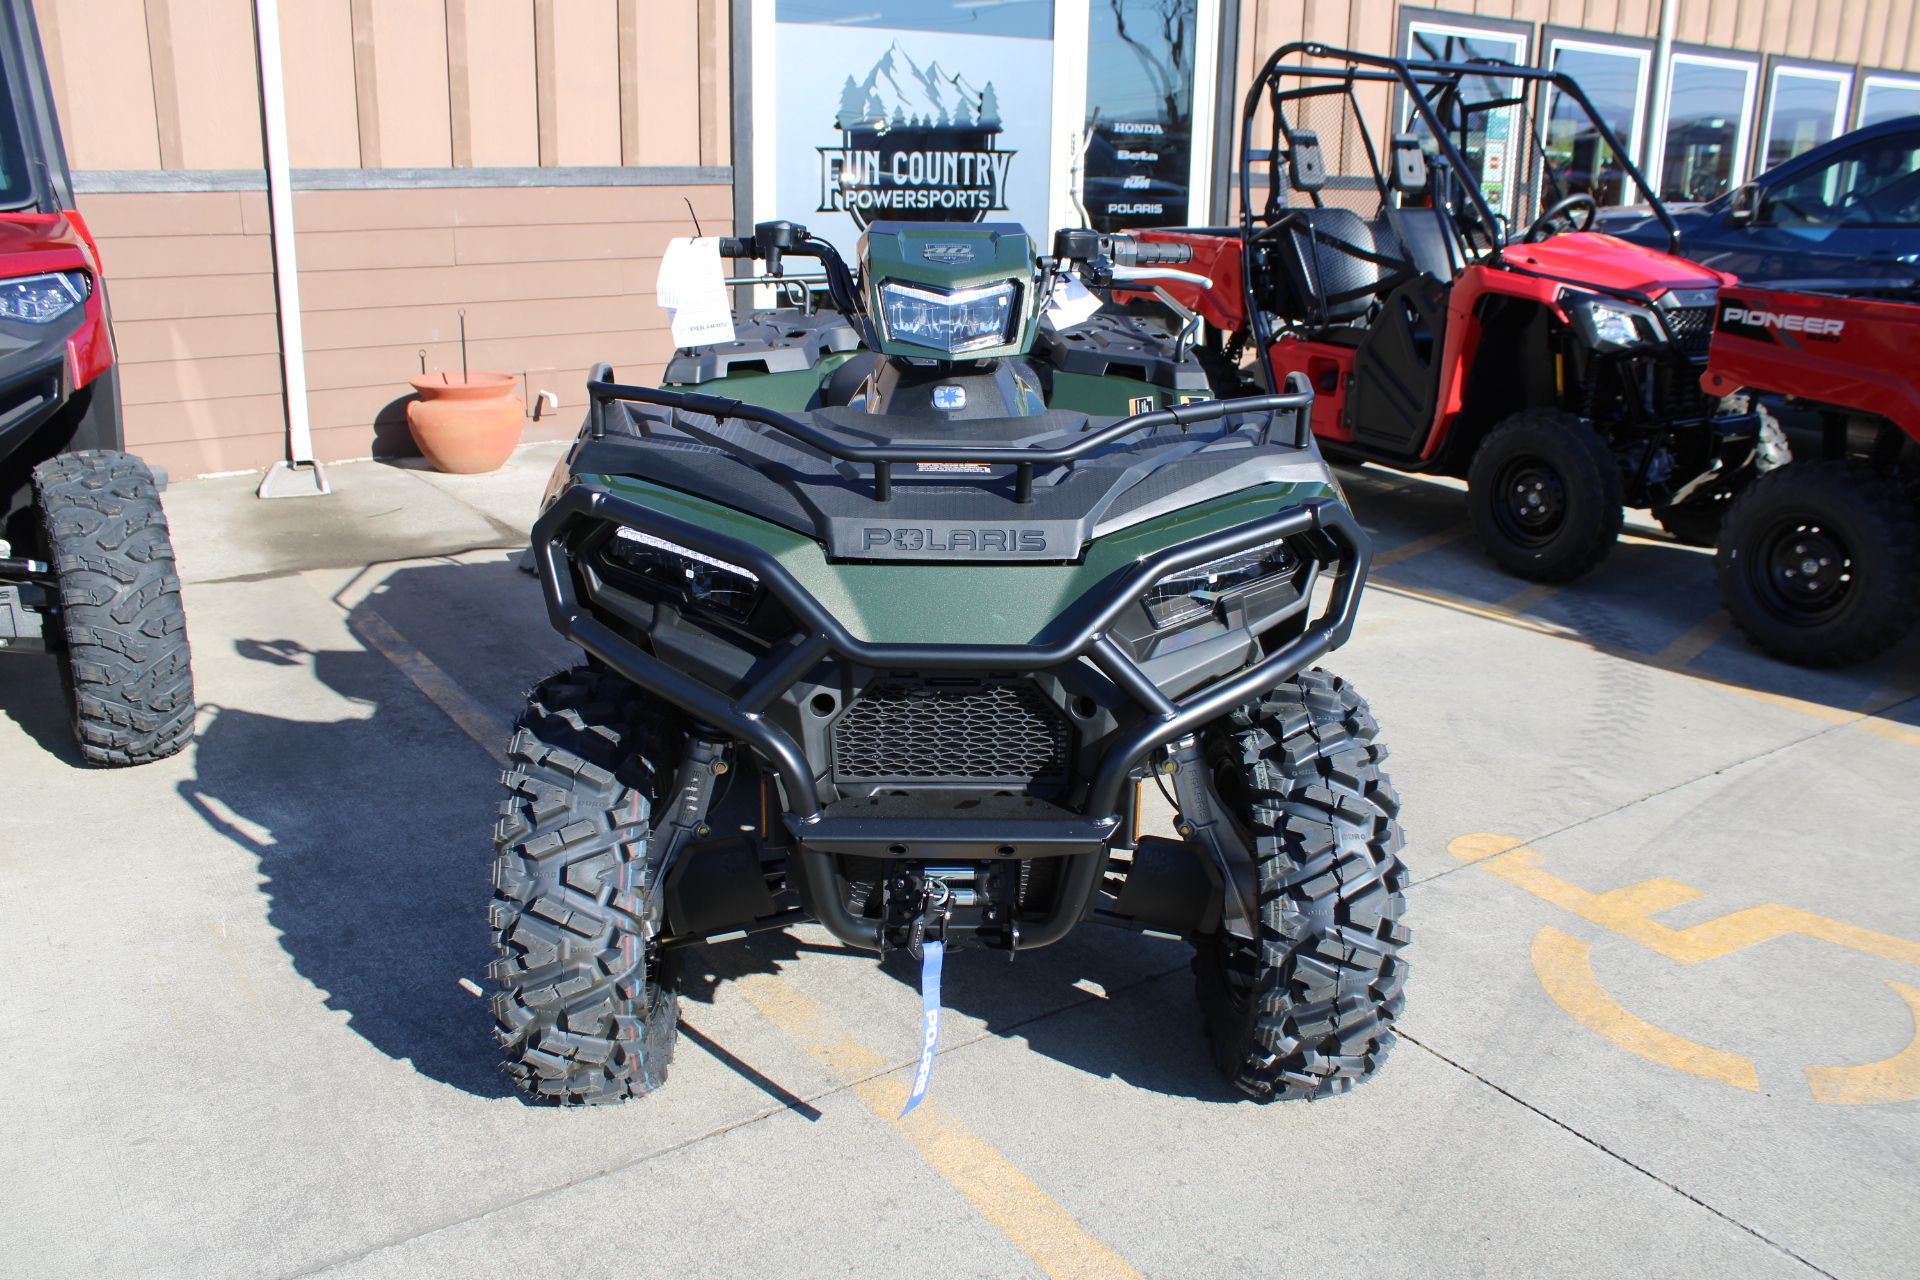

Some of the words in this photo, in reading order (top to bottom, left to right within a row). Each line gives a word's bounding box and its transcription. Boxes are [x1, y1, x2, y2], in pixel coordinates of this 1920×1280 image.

[1114, 122, 1164, 134] HONDA
[1117, 149, 1159, 161] Beta
[818, 149, 881, 211] FUN
[892, 150, 1015, 210] COUNTRY
[1123, 175, 1151, 189] KTM
[845, 190, 990, 209] POWERSPORTS
[1108, 204, 1163, 214] POLARIS
[1724, 307, 1845, 336] PIONEER
[863, 528, 1047, 552] POLARIS
